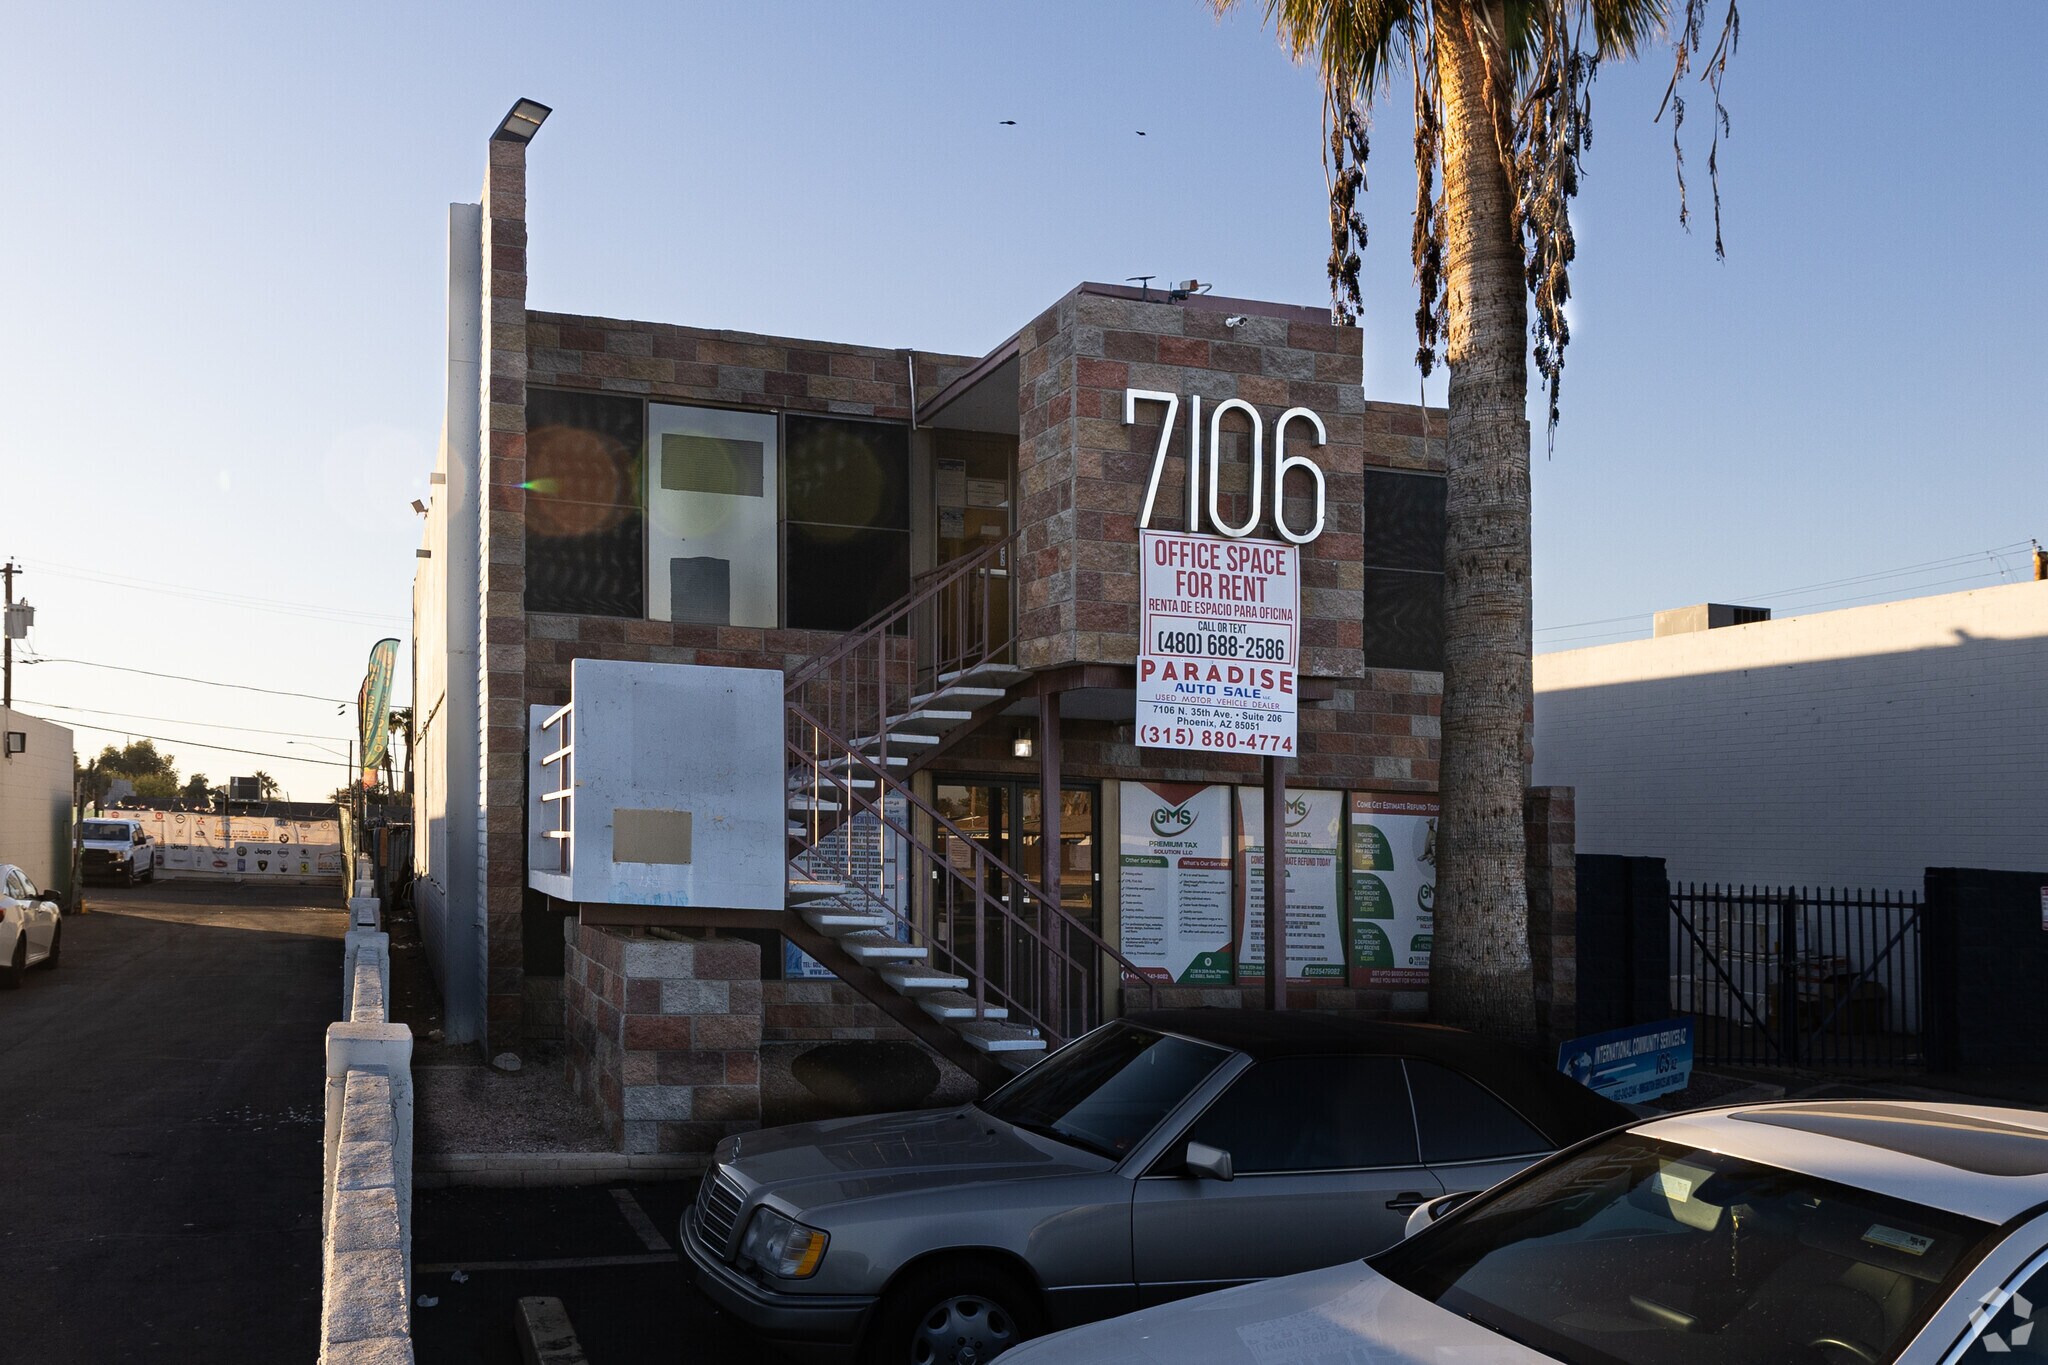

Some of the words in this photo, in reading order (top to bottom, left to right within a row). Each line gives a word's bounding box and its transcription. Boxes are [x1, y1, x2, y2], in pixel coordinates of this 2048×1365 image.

[1122, 388, 1326, 544] 7106
[1155, 540, 1221, 570] OFFICE
[1227, 546, 1286, 576] SPACE
[1177, 570, 1212, 599] FOR
[1219, 574, 1267, 602] RENT
[1149, 598, 1178, 612] RENTA
[1181, 601, 1192, 613] DE
[1195, 602, 1232, 616] ESPACIO
[1235, 605, 1257, 618] PARA
[1260, 607, 1293, 621] OFICINA
[1198, 621, 1216, 632] CALL
[1218, 623, 1227, 633] OR
[1229, 623, 1247, 634] TEXT
[1158, 631, 1202, 654] (480)
[1208, 635, 1284, 660] 688-2586
[1141, 660, 1293, 694] PARADISE
[1175, 683, 1216, 695] AUTO
[1224, 687, 1261, 699] SALE
[1153, 705, 1175, 714] 7106
[1191, 709, 1210, 717] 35th
[1214, 710, 1233, 719] Ave.
[1242, 712, 1264, 721] Suite
[1267, 714, 1282, 722] 206
[1217, 699, 1247, 707] VEHICLE
[1252, 702, 1280, 710] DEALER
[1177, 717, 1217, 728] Phoenix,
[1220, 720, 1232, 728] AZ
[1235, 721, 1260, 730] 85051
[1141, 725, 1194, 746] (315)
[1202, 730, 1292, 752] 880-4774
[1154, 801, 1191, 825] GMS
[1285, 792, 1306, 816] MS
[254, 848, 271, 856] Jeep
[1148, 840, 1183, 849] PREMIUM
[1184, 841, 1198, 849] TAX
[1594, 1038, 1632, 1065] INTERNATIONAL
[1655, 1050, 1671, 1075] ICS
